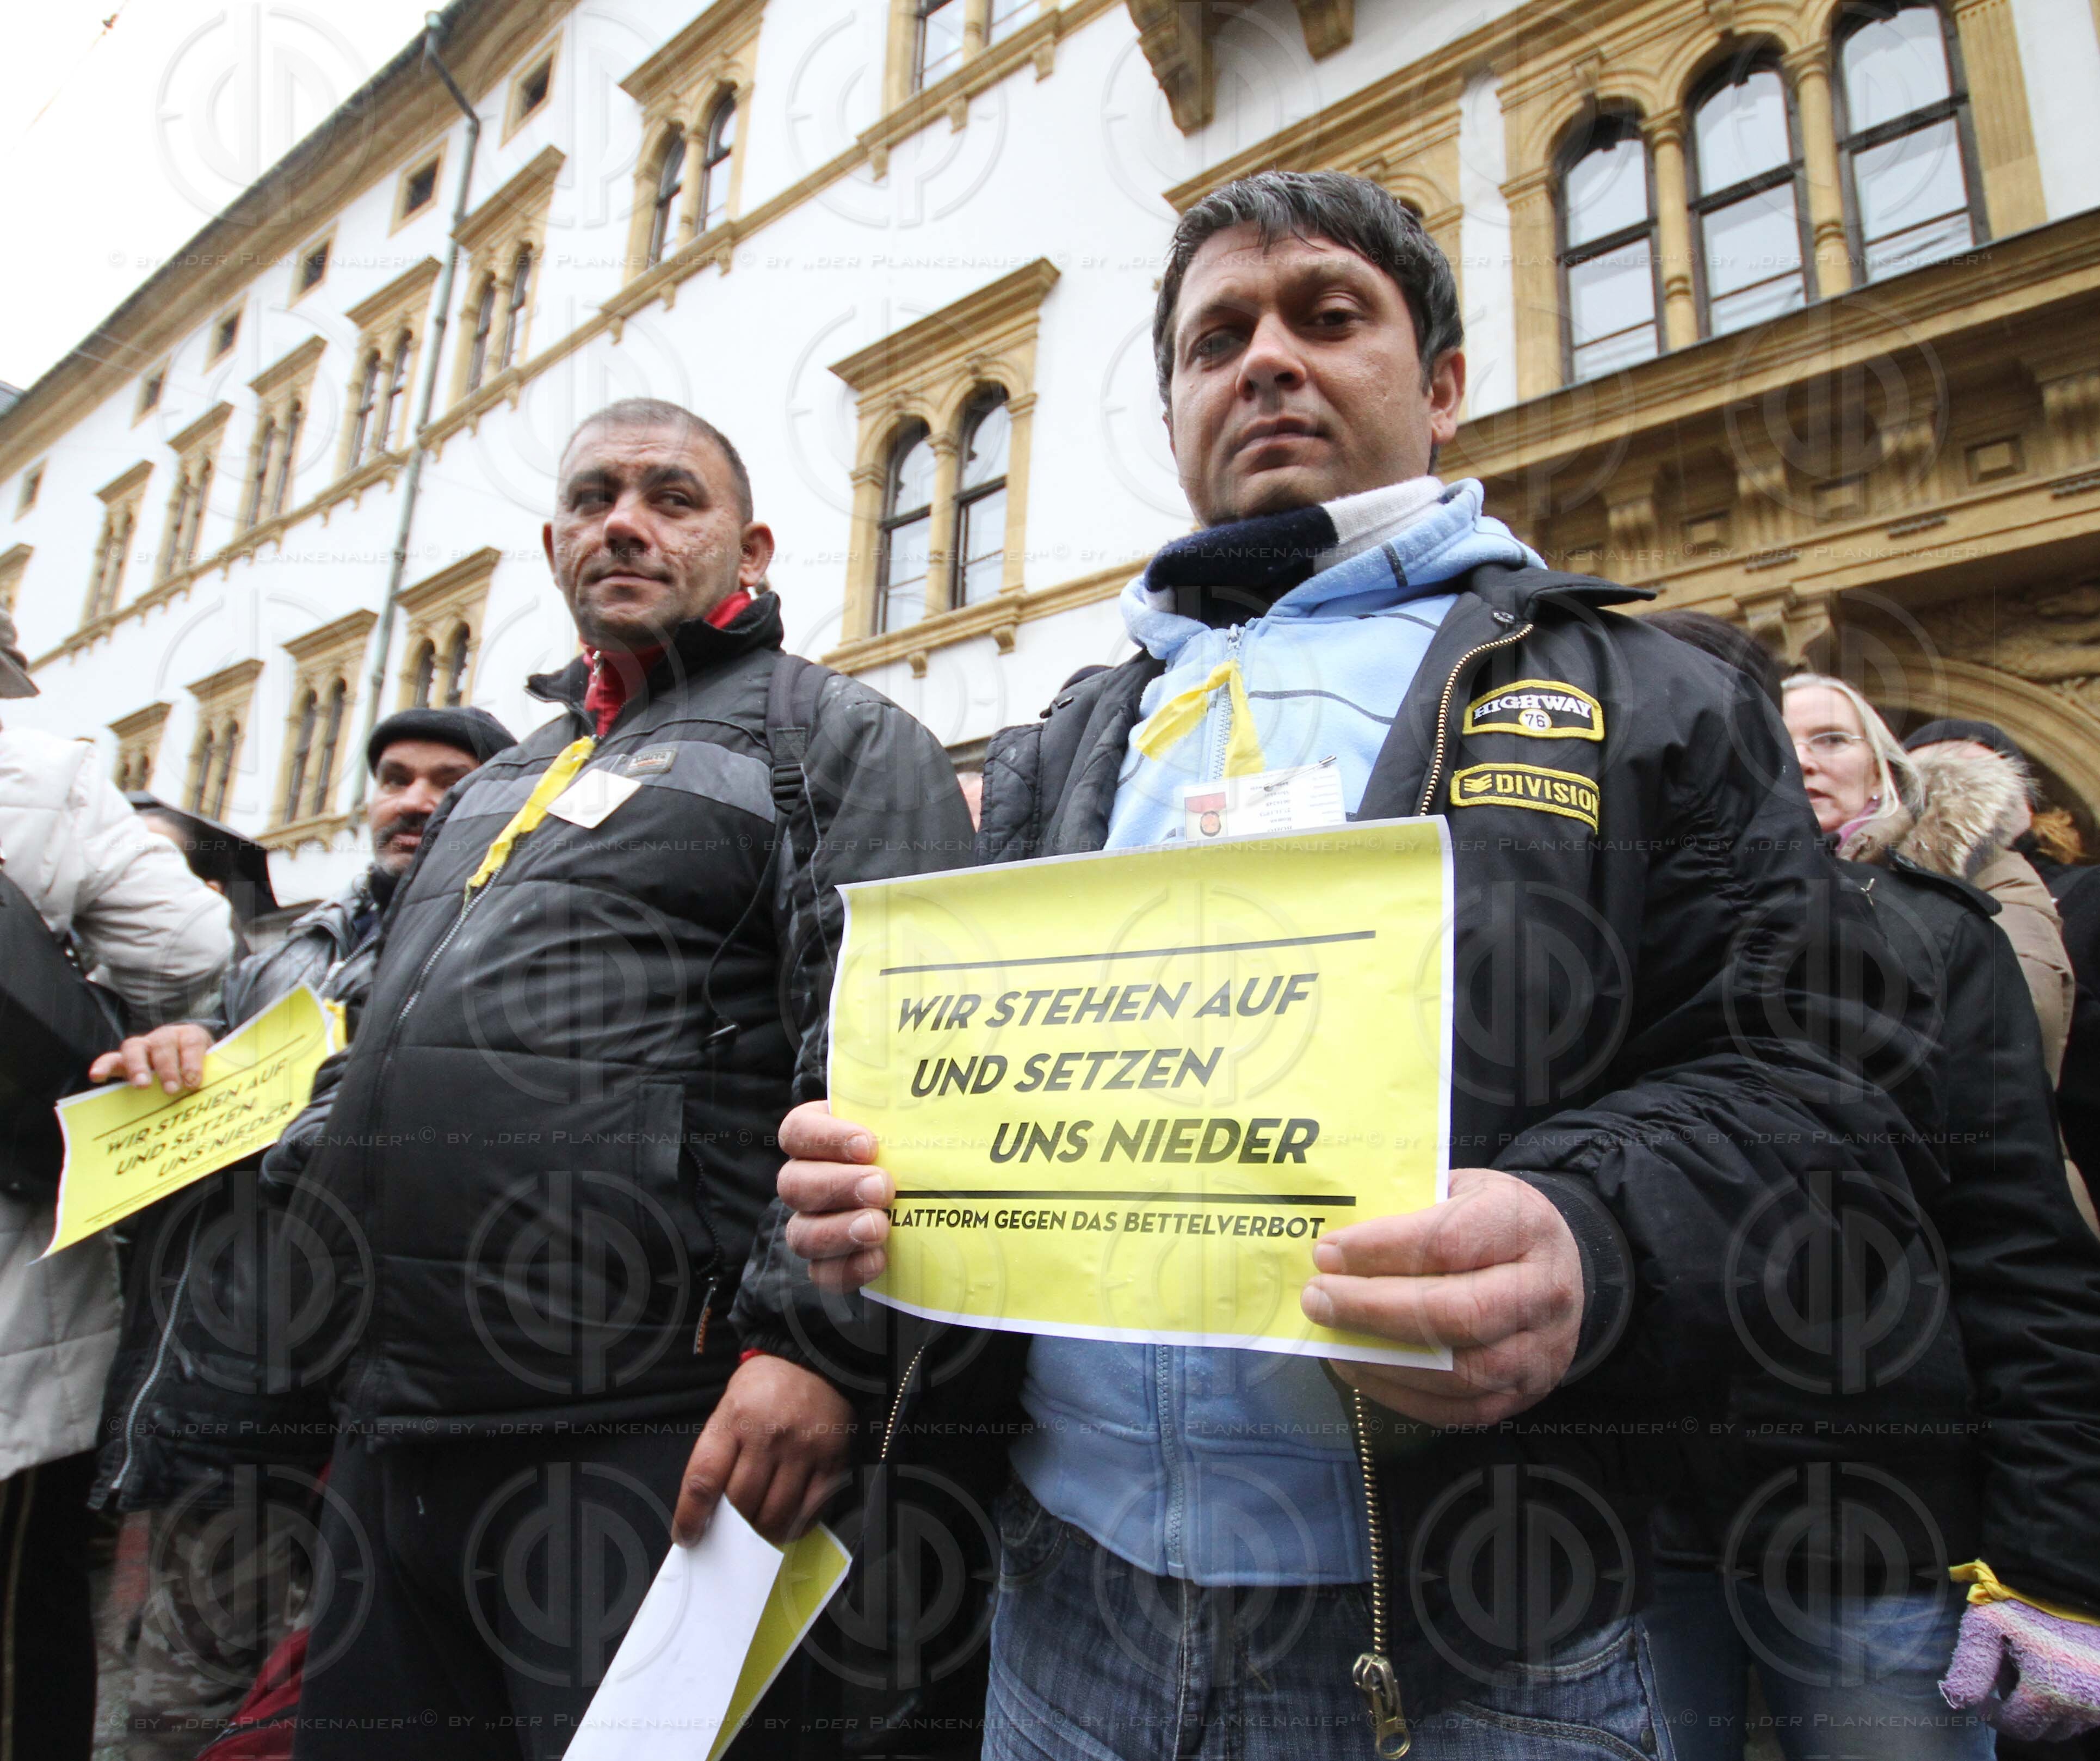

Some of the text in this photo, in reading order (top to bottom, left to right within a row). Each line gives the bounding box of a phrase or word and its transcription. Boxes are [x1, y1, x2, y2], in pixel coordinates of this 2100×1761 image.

[1474, 694, 1592, 719] HIGHWAY
[1525, 713, 1546, 728] 76
[898, 972, 1319, 1033] WIR STEHEN AUF
[911, 1047, 1224, 1098] UND SETZEN
[107, 1057, 287, 1155] WIR STEHEN AUF
[116, 1097, 257, 1175] UND SETZEN
[157, 1101, 293, 1177] UNS NIEDER
[990, 1118, 1319, 1164] UNS NIEDER
[995, 1210, 1067, 1229] GEGEN
[1071, 1211, 1117, 1232] DAS
[1123, 1212, 1325, 1239] BETTELVERBOT
